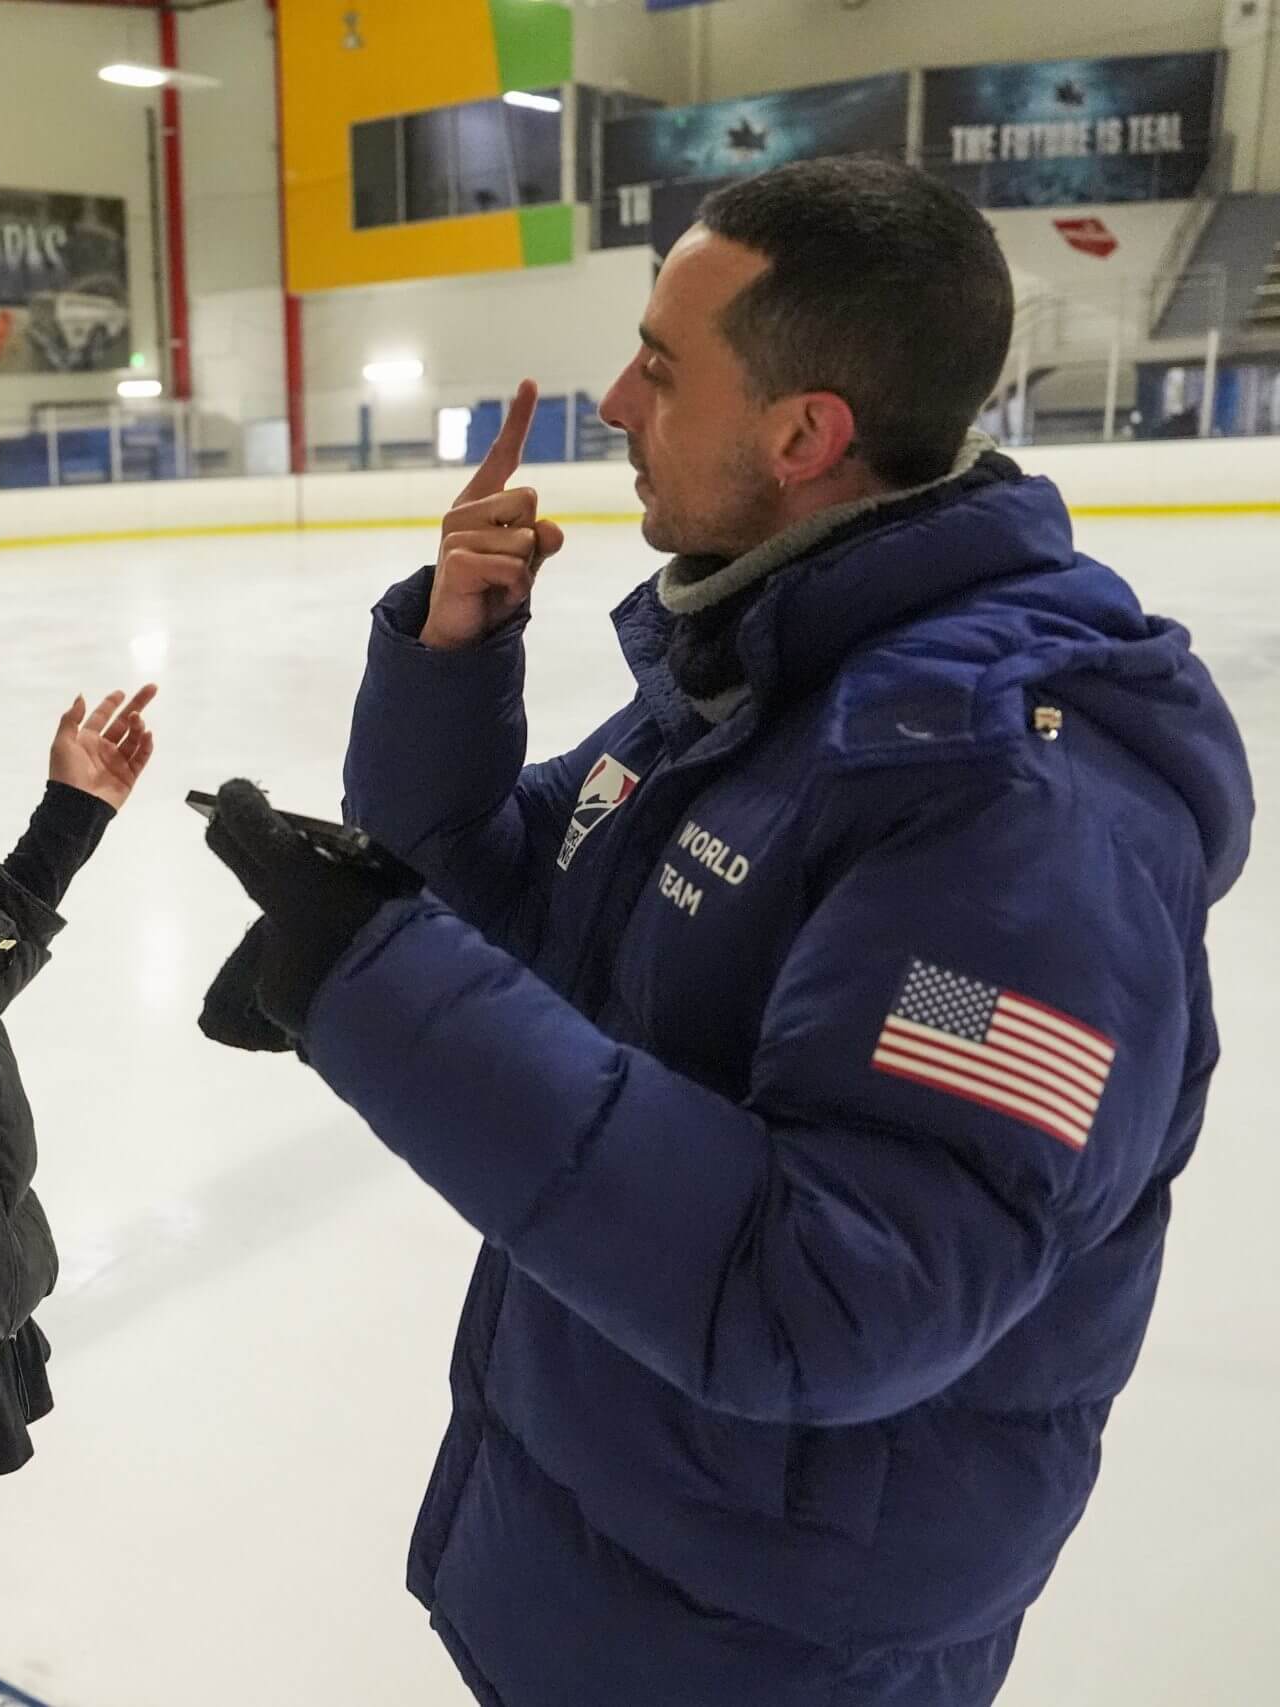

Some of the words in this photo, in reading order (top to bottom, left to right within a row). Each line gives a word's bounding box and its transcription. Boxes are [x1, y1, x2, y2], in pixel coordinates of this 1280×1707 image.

[949, 124, 996, 165] THE
[999, 119, 1090, 163] FUTURE
[1095, 115, 1123, 156] IS
[1127, 112, 1185, 155] TEAL
[677, 820, 749, 885] WORLD
[657, 862, 704, 917] TEAM
